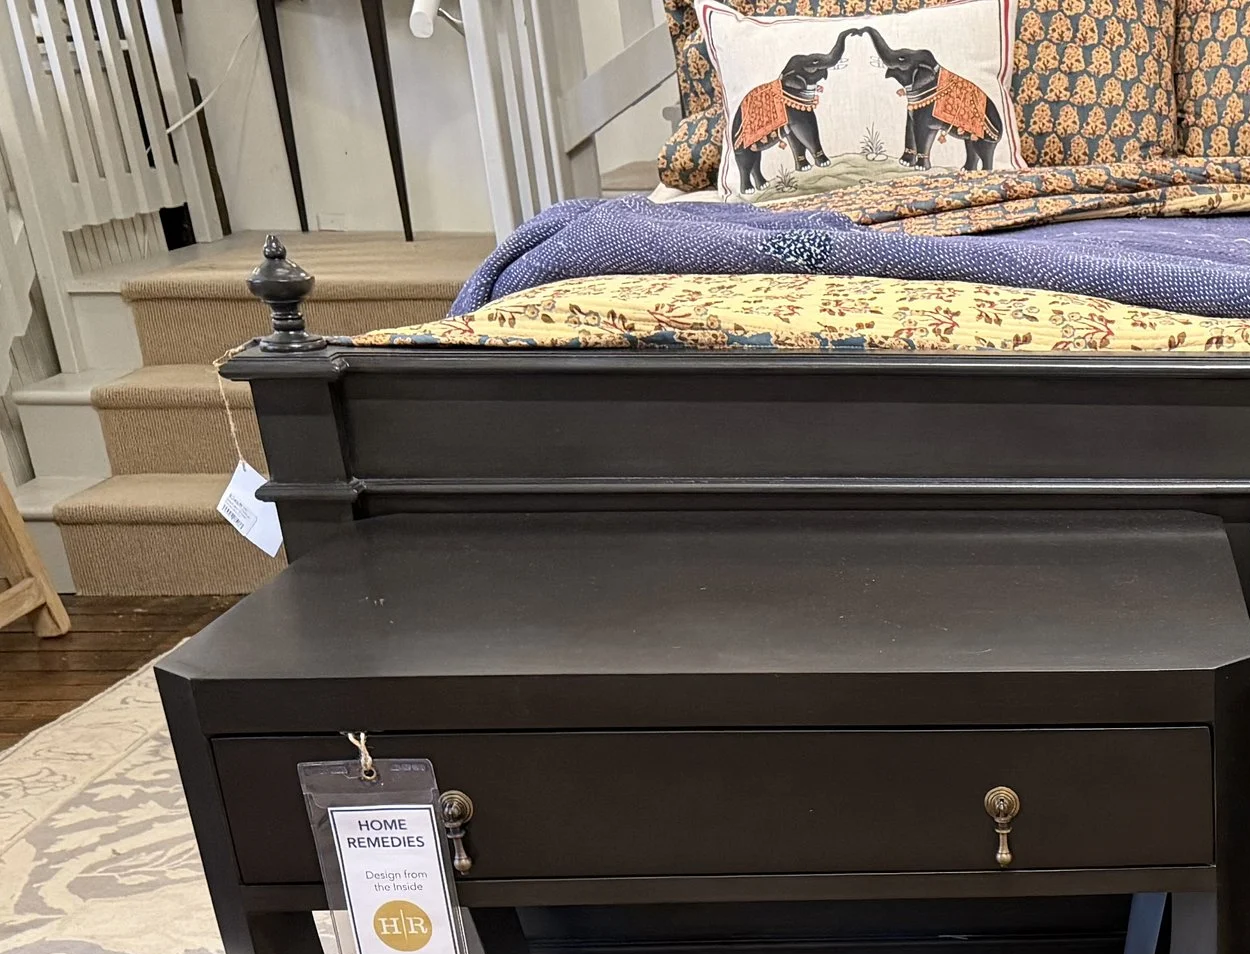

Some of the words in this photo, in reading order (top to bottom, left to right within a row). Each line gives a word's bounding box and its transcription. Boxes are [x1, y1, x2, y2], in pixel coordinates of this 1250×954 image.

[357, 819, 408, 831] HOME
[347, 836, 425, 848] REMEDIES
[365, 871, 401, 881] Design
[404, 870, 428, 879] from
[374, 882, 391, 891] the
[393, 882, 423, 891] Inside
